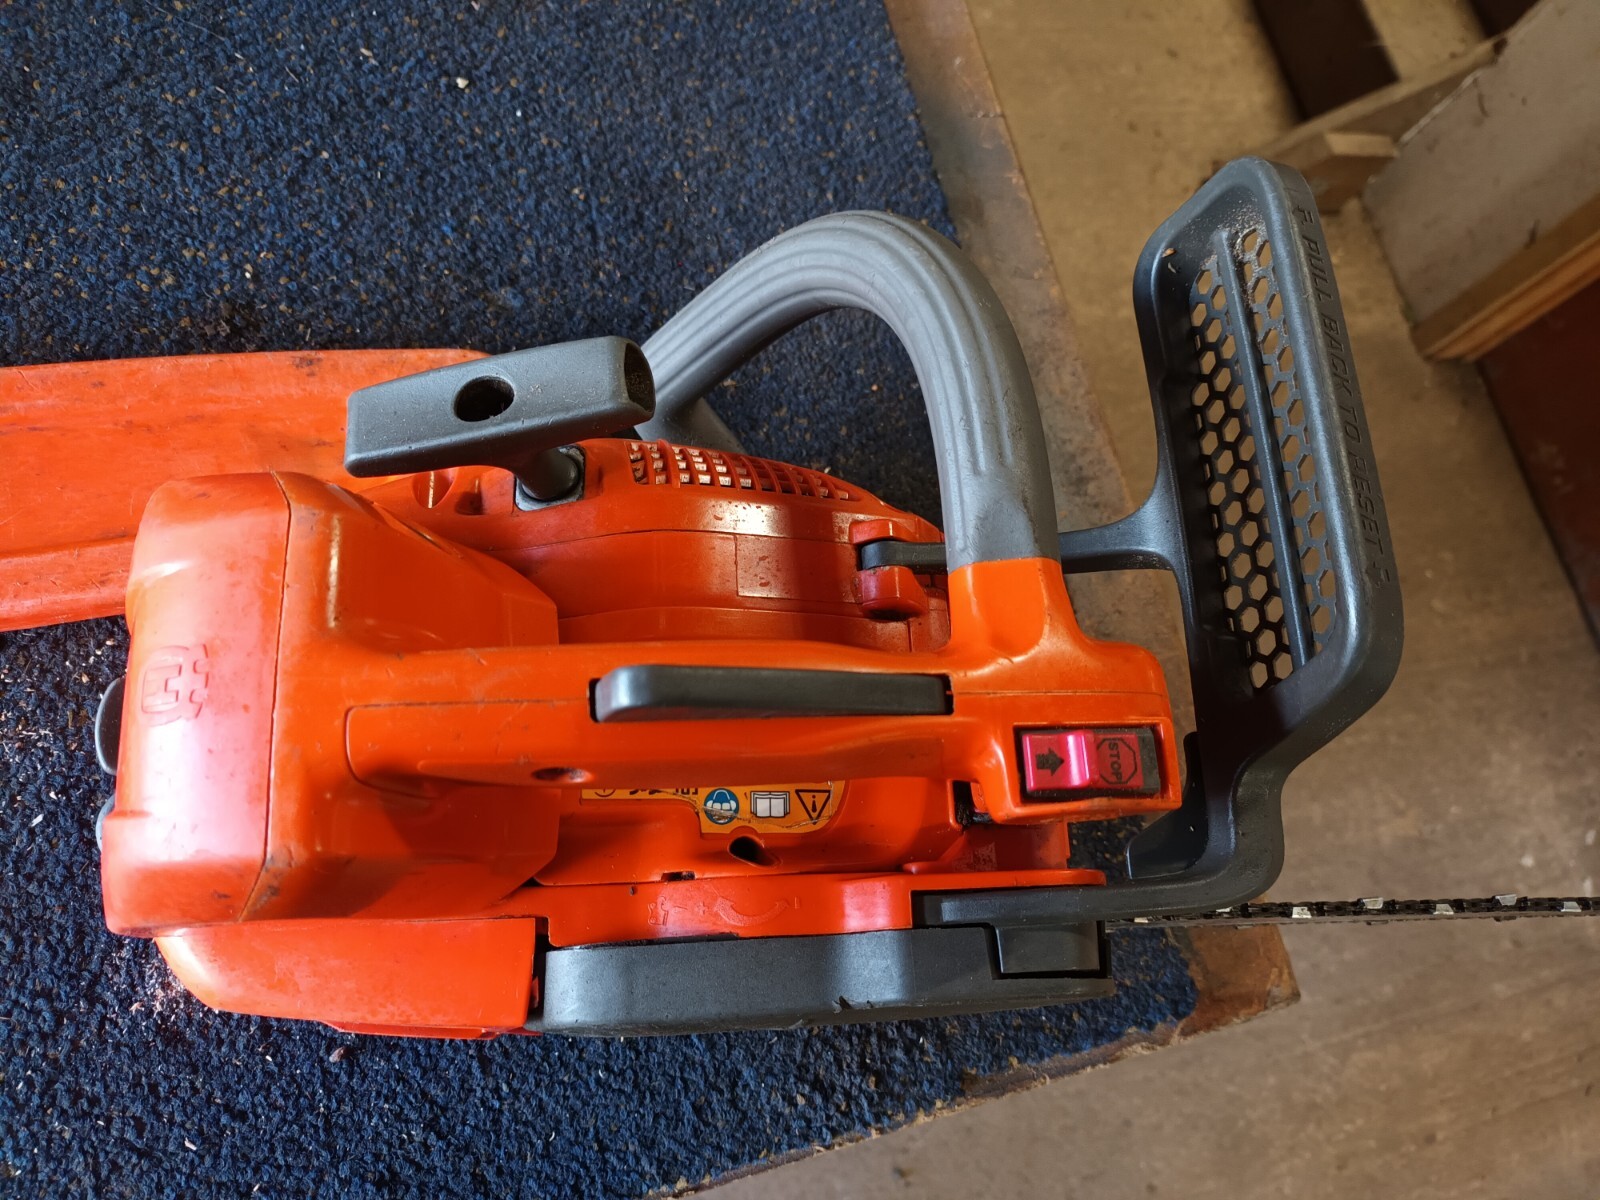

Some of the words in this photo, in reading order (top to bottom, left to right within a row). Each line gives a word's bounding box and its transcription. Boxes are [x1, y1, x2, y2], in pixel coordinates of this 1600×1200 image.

[1302, 234, 1332, 302] PULL
[1321, 312, 1353, 398] BACK
[1339, 405, 1361, 443] TO
[1350, 450, 1384, 554] RESET
[1108, 742, 1123, 783] STOP
